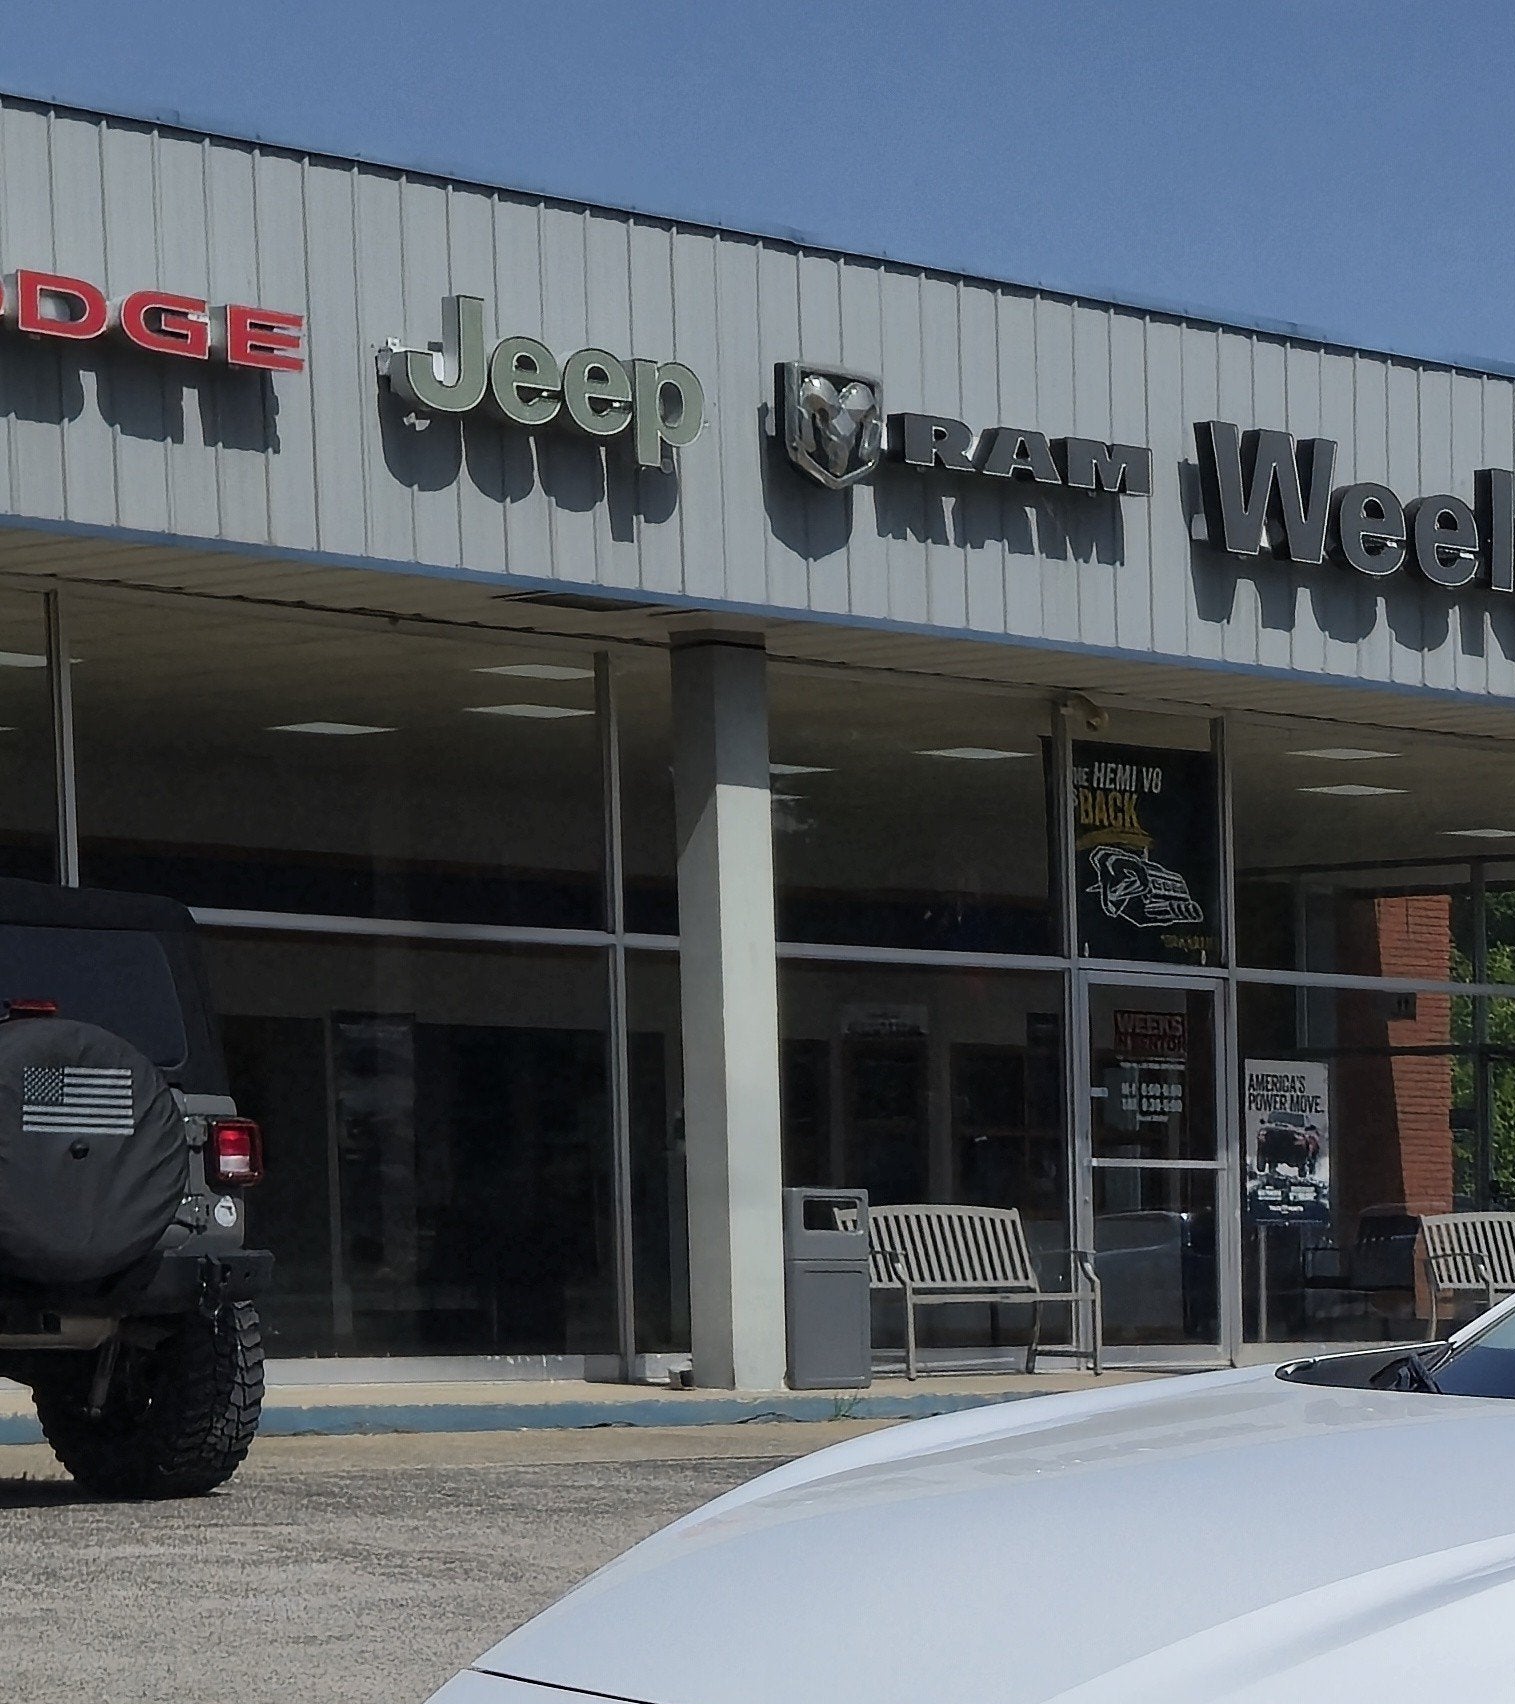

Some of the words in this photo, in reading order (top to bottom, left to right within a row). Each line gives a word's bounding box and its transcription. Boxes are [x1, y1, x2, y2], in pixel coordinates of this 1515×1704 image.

[0, 269, 305, 371] DGE
[402, 294, 706, 468] Jeep
[893, 413, 1153, 496] RAM
[1073, 766, 1089, 786] HE
[1092, 761, 1137, 791] HEMI
[1142, 766, 1163, 794] V8
[1079, 787, 1140, 832] BACK
[1117, 1013, 1183, 1036] WEEKS
[1248, 1073, 1306, 1094] AMERICA'S
[1248, 1092, 1287, 1112] POWER
